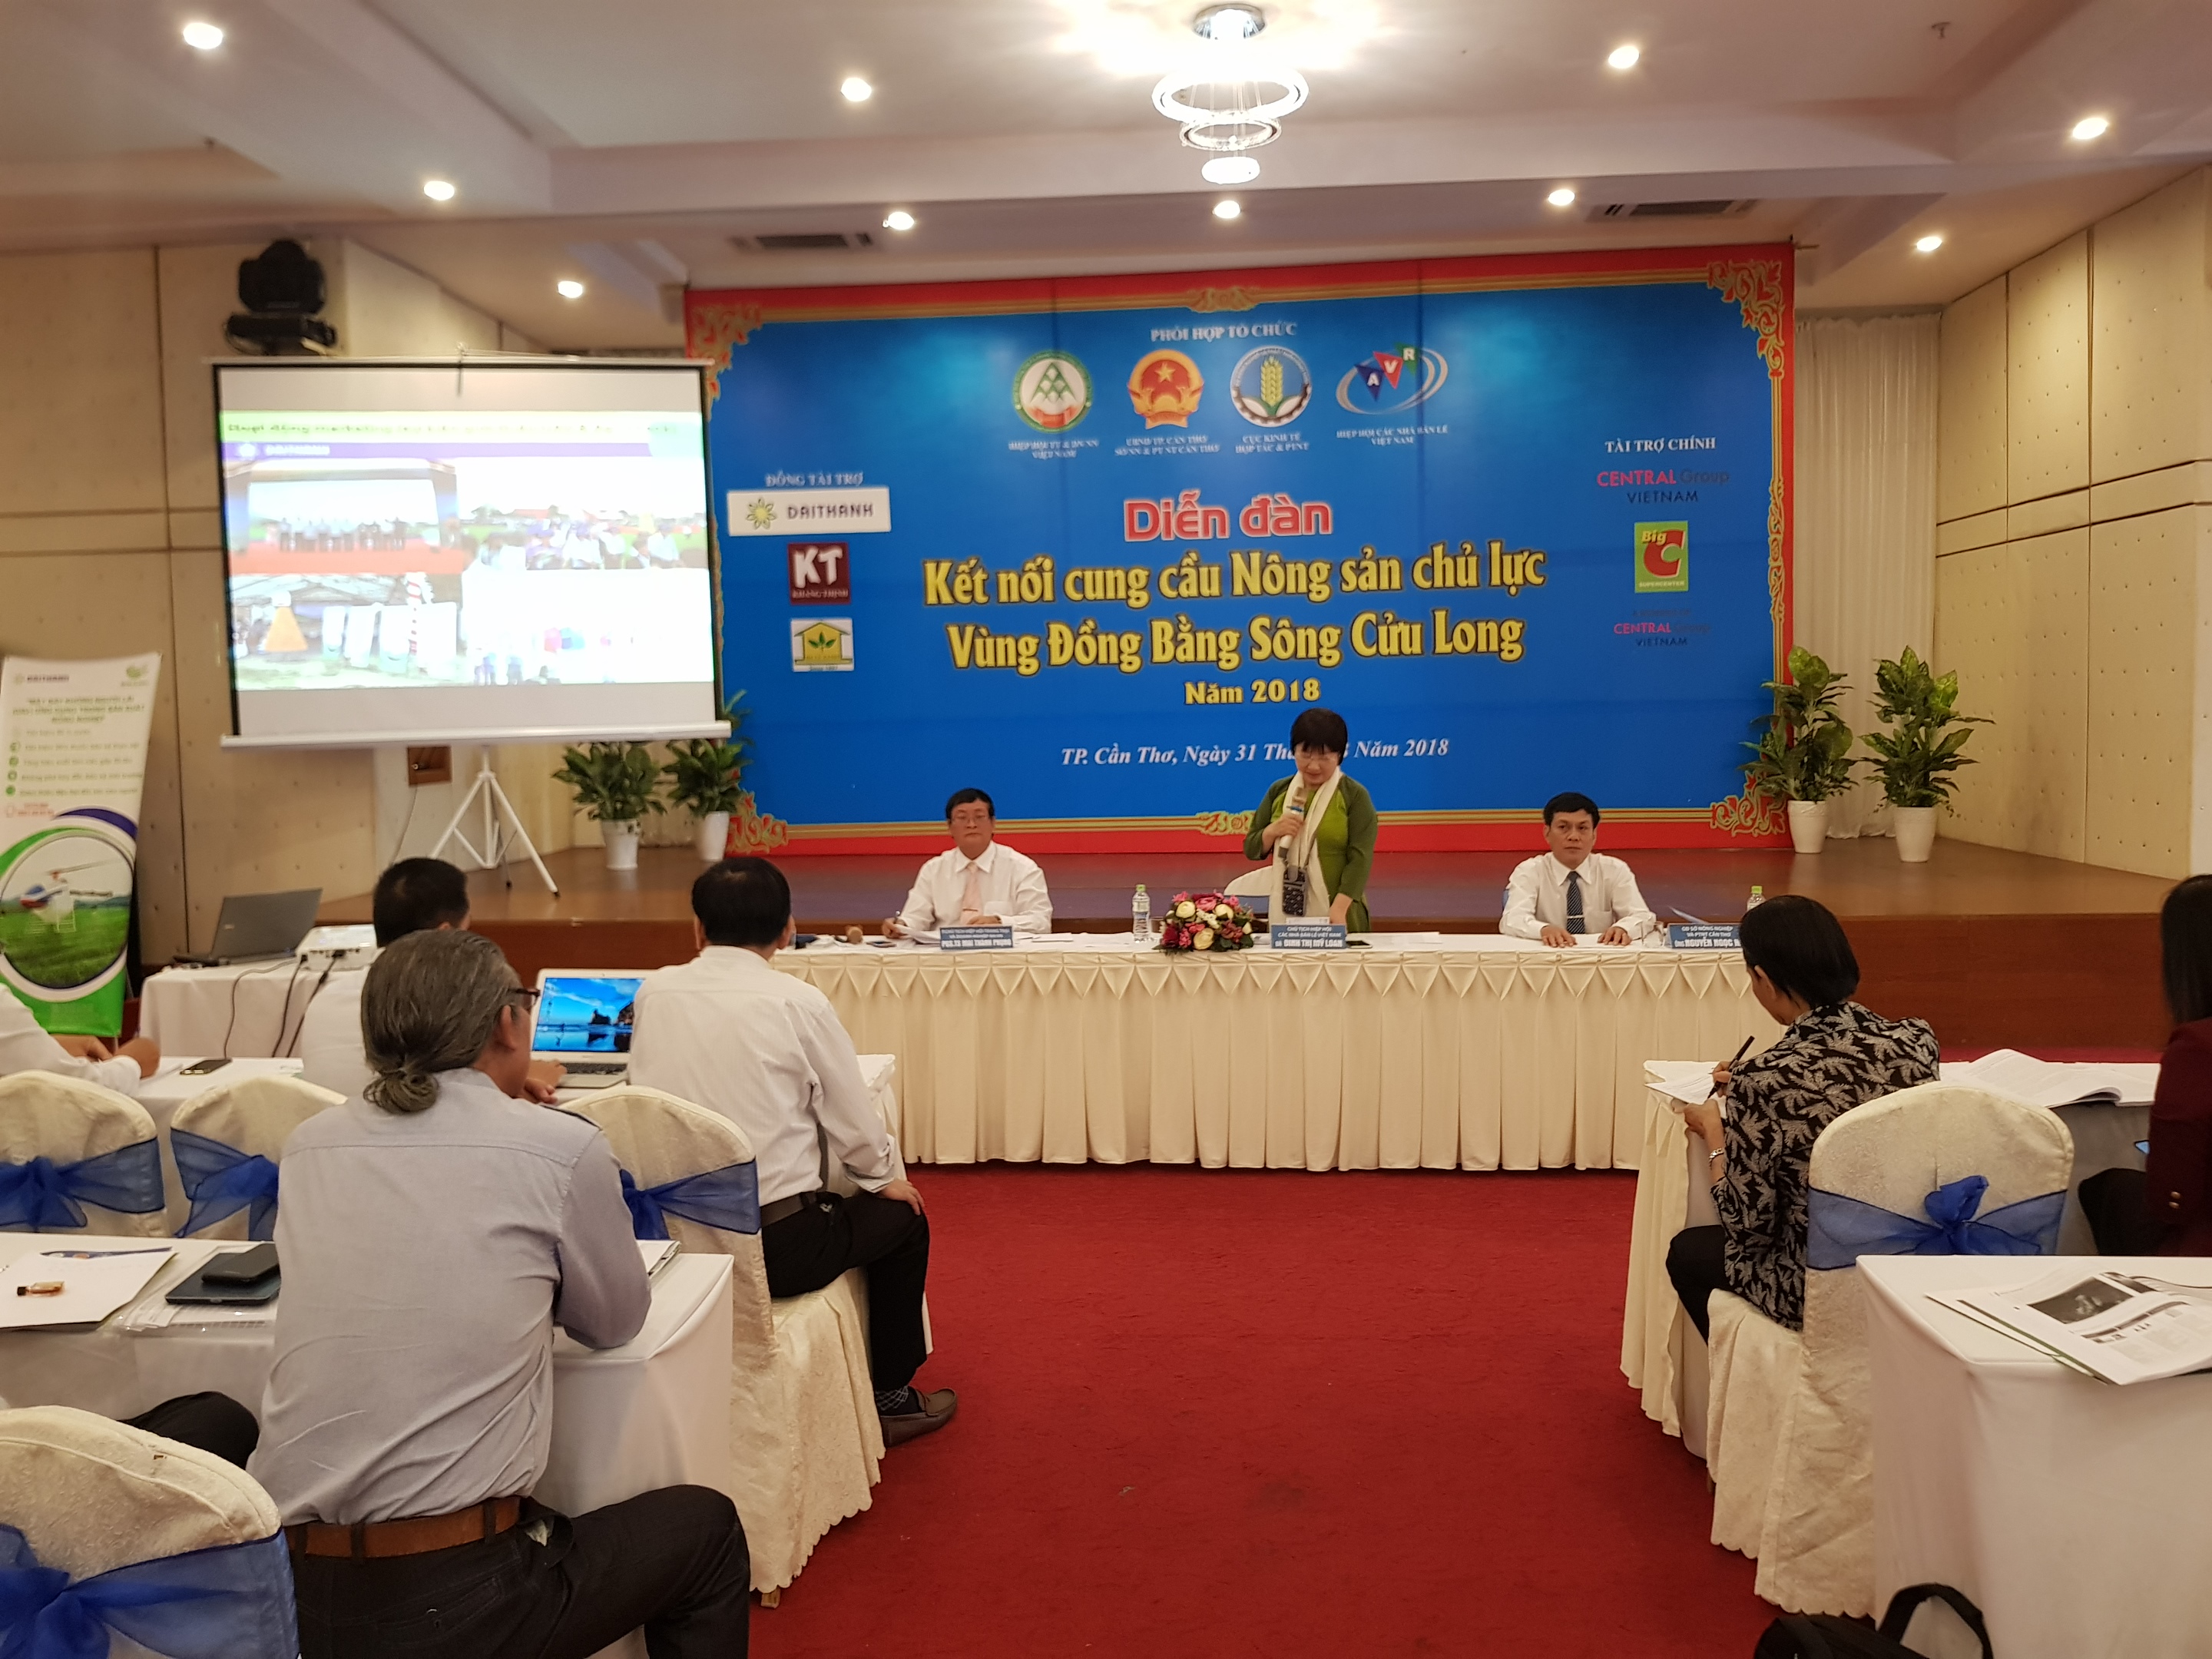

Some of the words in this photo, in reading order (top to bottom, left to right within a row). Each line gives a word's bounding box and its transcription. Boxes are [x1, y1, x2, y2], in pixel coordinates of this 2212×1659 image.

[1251, 320, 1297, 337] CHỨC
[1604, 437, 1631, 453] TÀI
[1634, 437, 1665, 454] TRỢ
[1667, 435, 1717, 451] CHÍNH
[809, 471, 832, 486] TÀI
[1597, 469, 1677, 488] CENTRAL
[1627, 490, 1699, 505] VIETNAM
[787, 503, 873, 520] DAITHANH
[1124, 489, 1230, 541] Diễn
[1239, 493, 1333, 538] đàn
[1641, 530, 1668, 546] Big
[1644, 529, 1686, 578] C
[793, 545, 843, 589] KT
[924, 556, 990, 606] Kết
[996, 553, 1056, 604] nối
[1063, 565, 1151, 610] cung
[1157, 549, 1223, 599] cầu
[1230, 549, 1332, 603] Nông
[1339, 545, 1403, 593] sản
[1411, 541, 1480, 591] chủ
[1488, 539, 1546, 598] lực
[1614, 621, 1672, 635] CENTRAL
[945, 623, 1041, 677] Vùng
[1046, 617, 1144, 674] Đồng
[1150, 613, 1241, 672] Bằng
[1248, 614, 1343, 668] Sông
[1349, 610, 1424, 658] Cửu
[1431, 608, 1525, 663] Long
[1184, 680, 1243, 705] Năm
[1250, 677, 1322, 704] 2018
[1061, 747, 1088, 767] TP.
[1094, 742, 1132, 765] Cần
[1137, 746, 1178, 766] Thơ,
[1183, 743, 1231, 767] Ngày
[1234, 743, 1256, 762] 31
[1353, 739, 1399, 759] Năm
[1402, 737, 1450, 757] 2018
